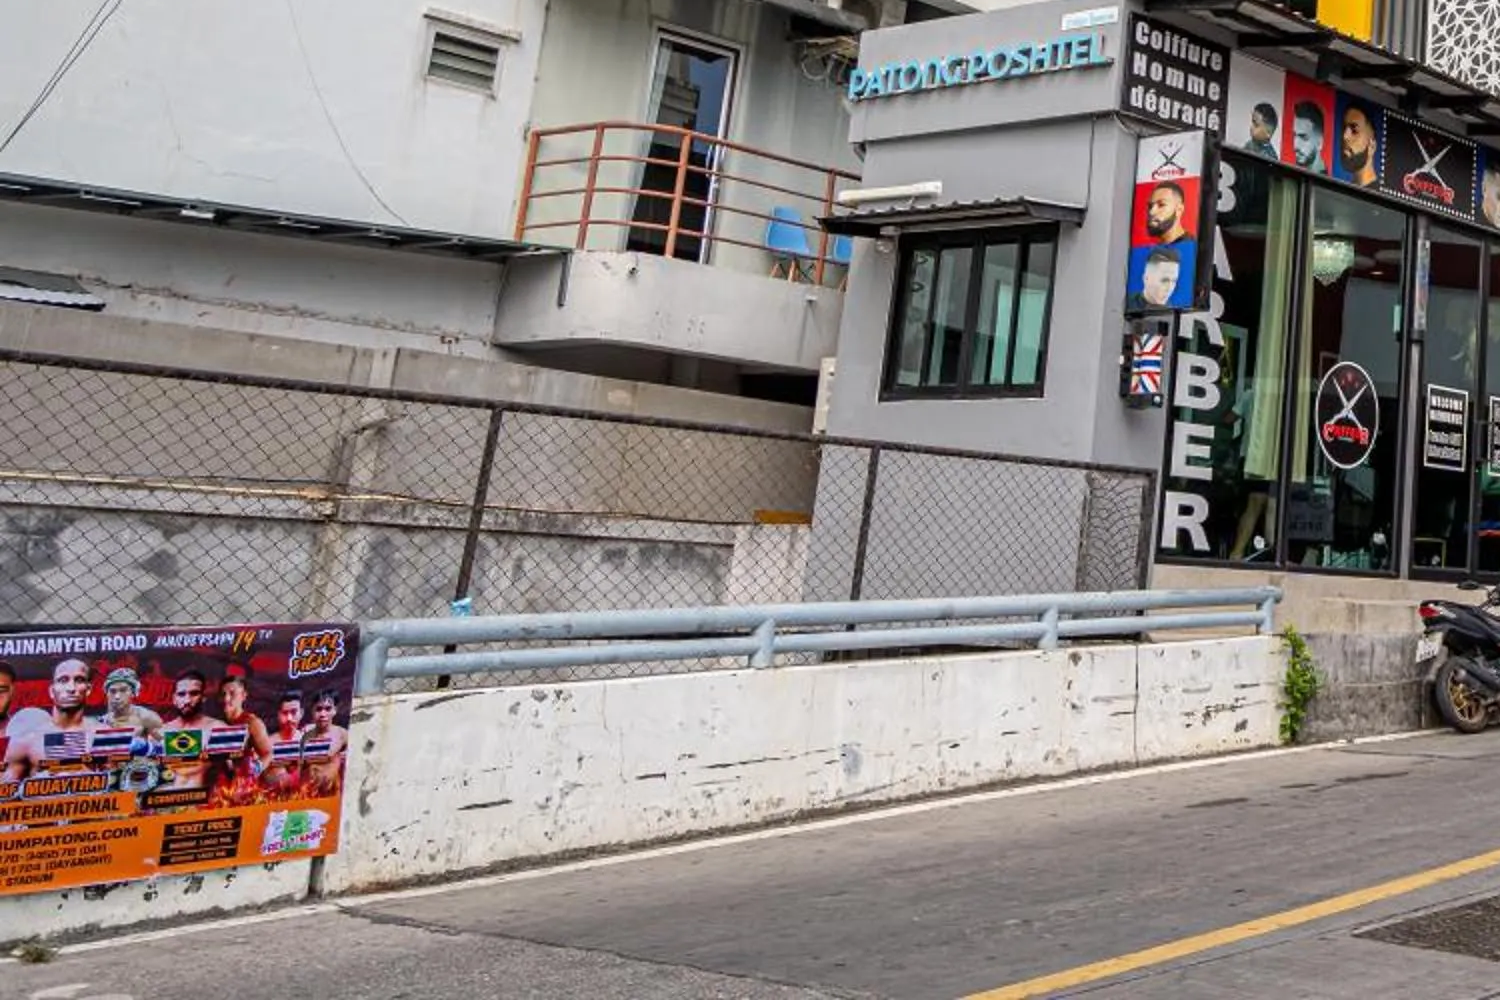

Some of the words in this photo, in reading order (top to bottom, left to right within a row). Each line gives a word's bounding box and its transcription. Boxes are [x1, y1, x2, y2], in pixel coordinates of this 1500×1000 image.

[1135, 21, 1223, 71] Coiffure
[1133, 51, 1221, 101] Homme
[1130, 85, 1221, 131] dégradé
[101, 634, 147, 651] ROAD
[0, 797, 119, 821] NTERNATIONAL
[0, 826, 139, 850] UMPATONG.COM
